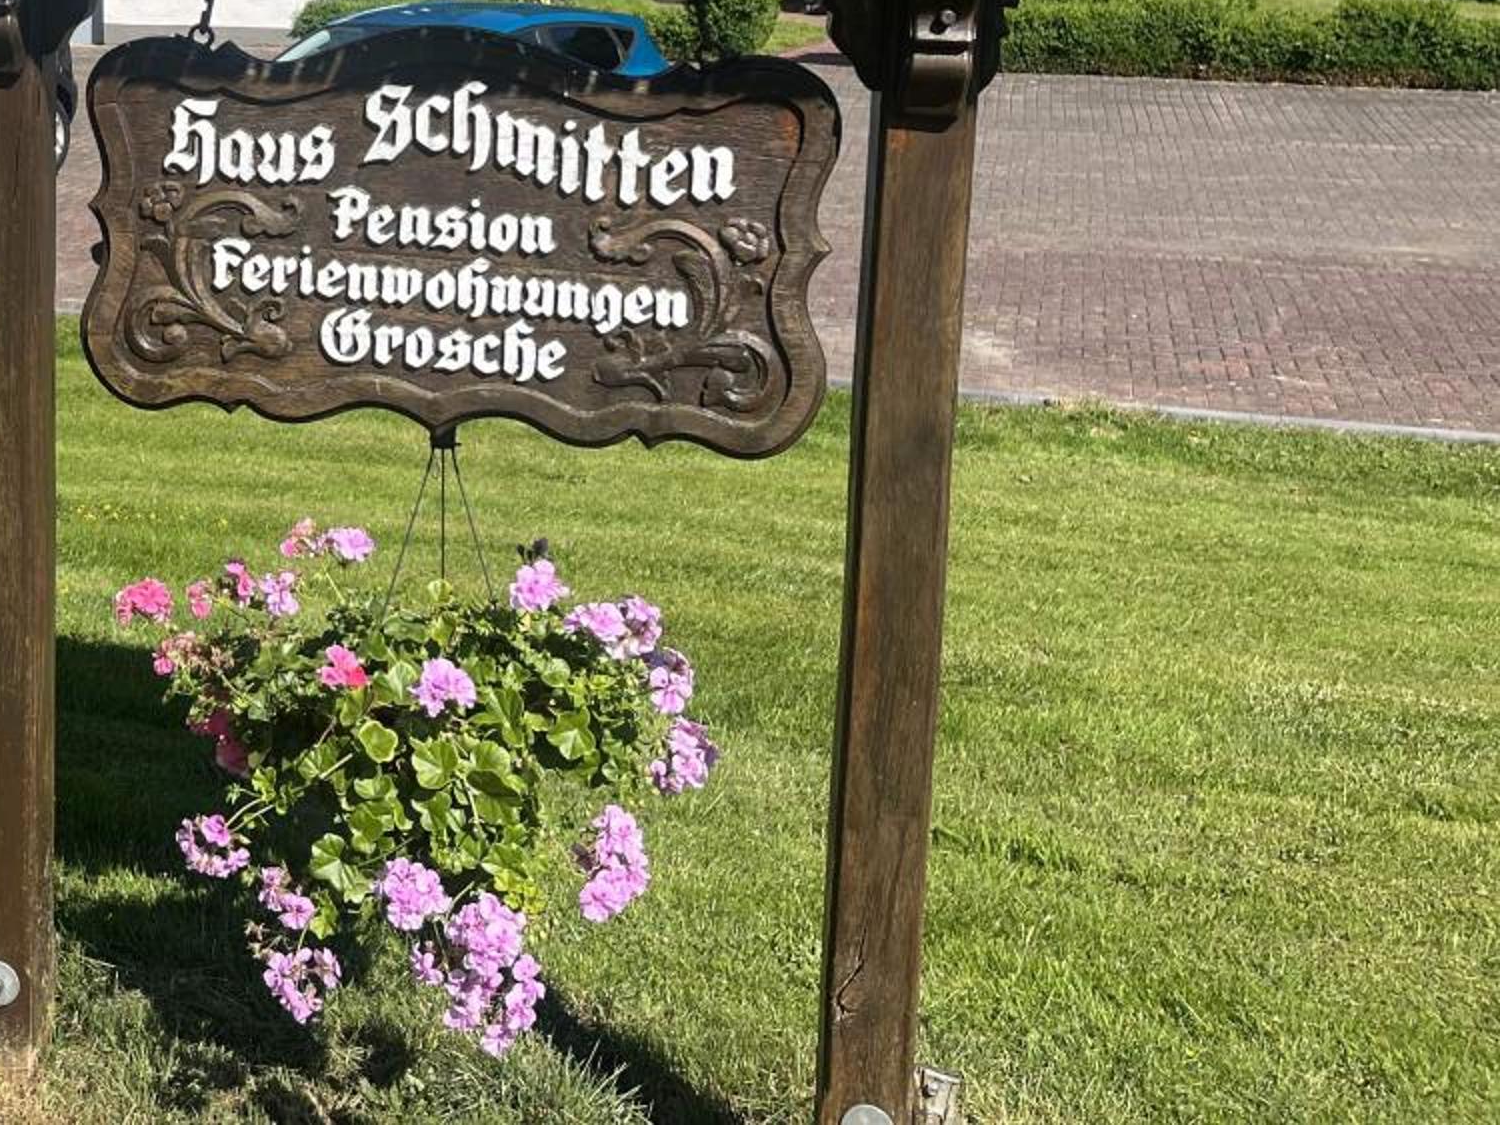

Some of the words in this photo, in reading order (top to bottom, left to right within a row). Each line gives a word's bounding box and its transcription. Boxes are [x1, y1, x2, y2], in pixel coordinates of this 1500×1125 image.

[162, 97, 336, 185] Haus
[362, 80, 738, 207] Schmitten
[328, 184, 557, 255] Pension
[211, 236, 690, 335] Ferienwohnungen
[319, 306, 568, 383] Grosche
